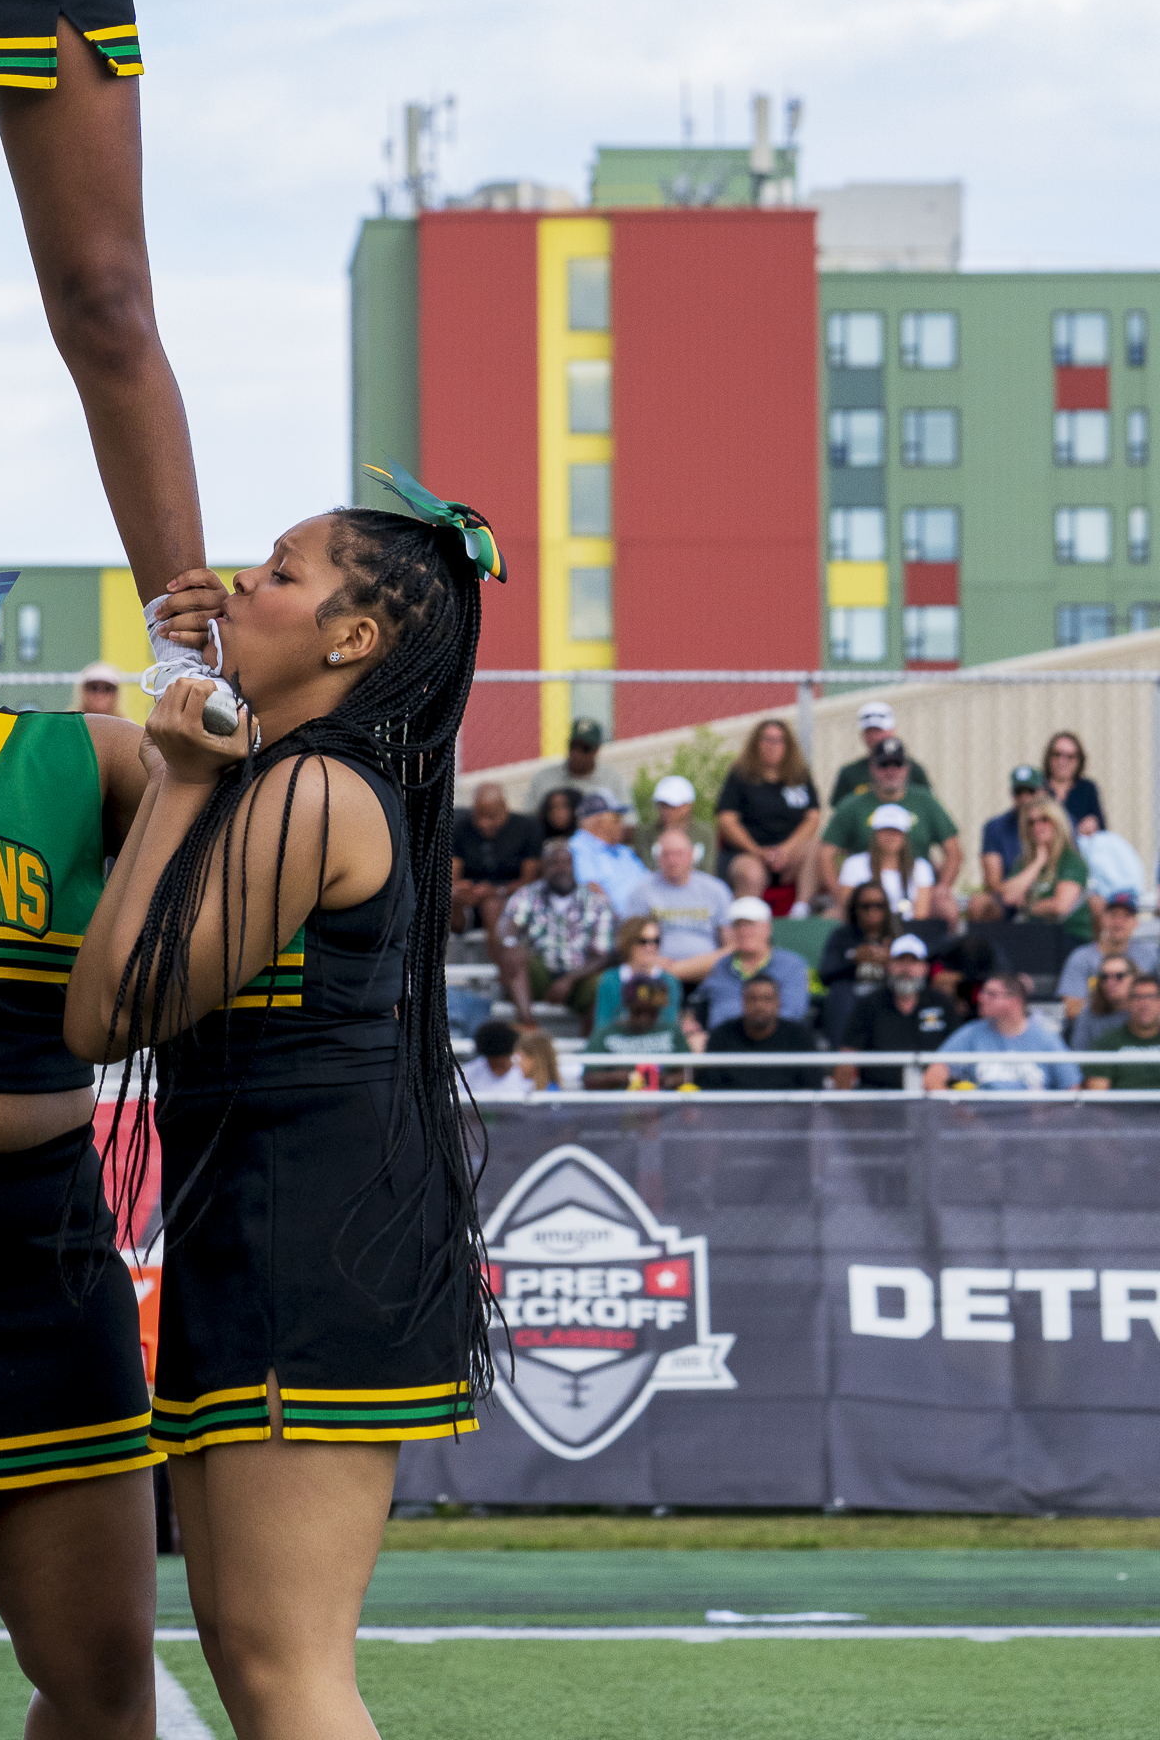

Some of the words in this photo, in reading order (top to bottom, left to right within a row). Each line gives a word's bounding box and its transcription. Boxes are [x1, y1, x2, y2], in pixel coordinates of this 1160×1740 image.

[505, 1268, 644, 1298] PREP
[848, 1263, 1160, 1342] DETR
[513, 1329, 636, 1349] CLASSIC
